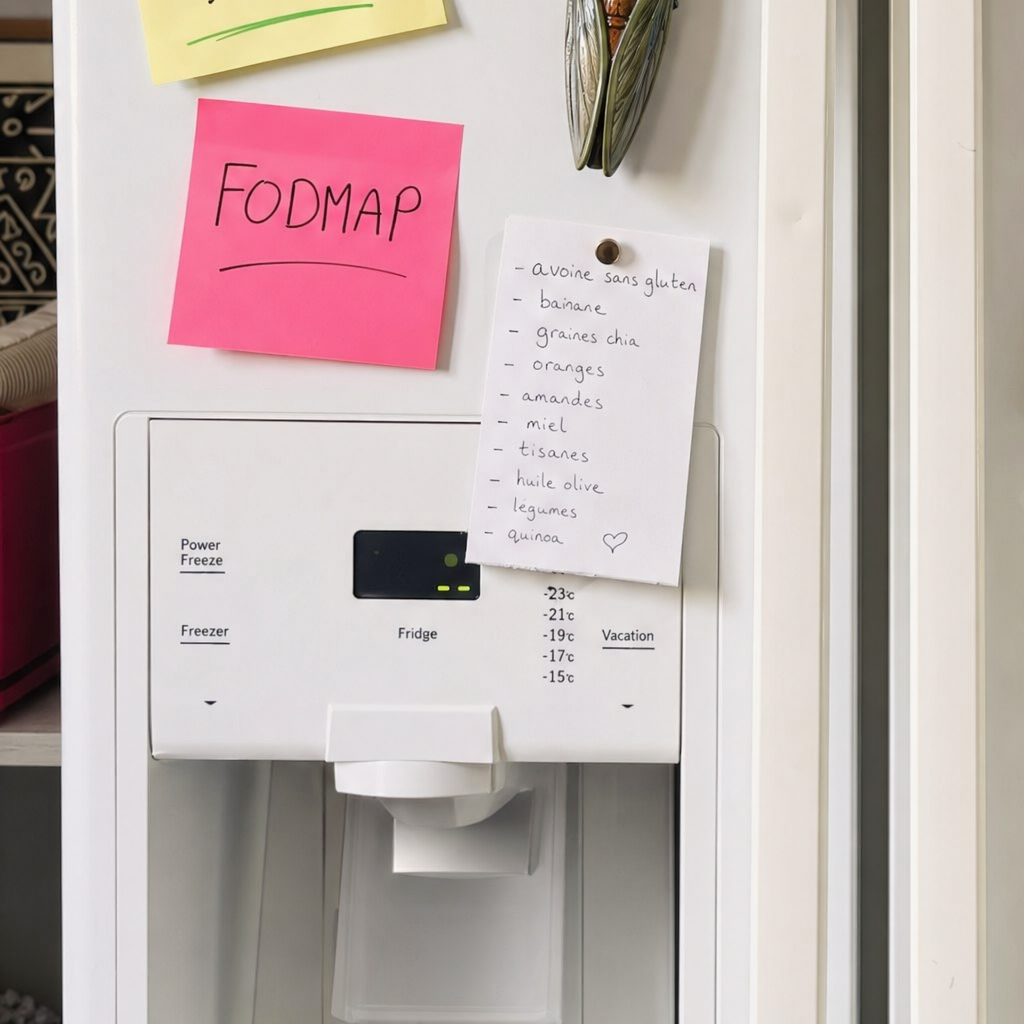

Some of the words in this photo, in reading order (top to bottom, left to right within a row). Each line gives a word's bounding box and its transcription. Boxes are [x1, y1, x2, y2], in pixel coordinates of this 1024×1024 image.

[214, 162, 422, 242] FODMAP
[531, 262, 594, 282] avoine
[604, 272, 639, 287] sans
[643, 268, 697, 298] gluten
[535, 326, 598, 349] graines
[606, 328, 640, 348] chia
[532, 359, 605, 384] oranges
[521, 389, 604, 410] amandes
[526, 416, 568, 434] miel
[518, 440, 589, 463] tisanes
[516, 468, 556, 490] huile
[563, 473, 605, 495] olive
[180, 538, 221, 551] Power
[507, 528, 564, 545] quinoa
[180, 553, 224, 566] Freeze
[181, 624, 230, 638] Freezer
[398, 627, 438, 643] Fridge
[601, 629, 655, 642] Vacation
